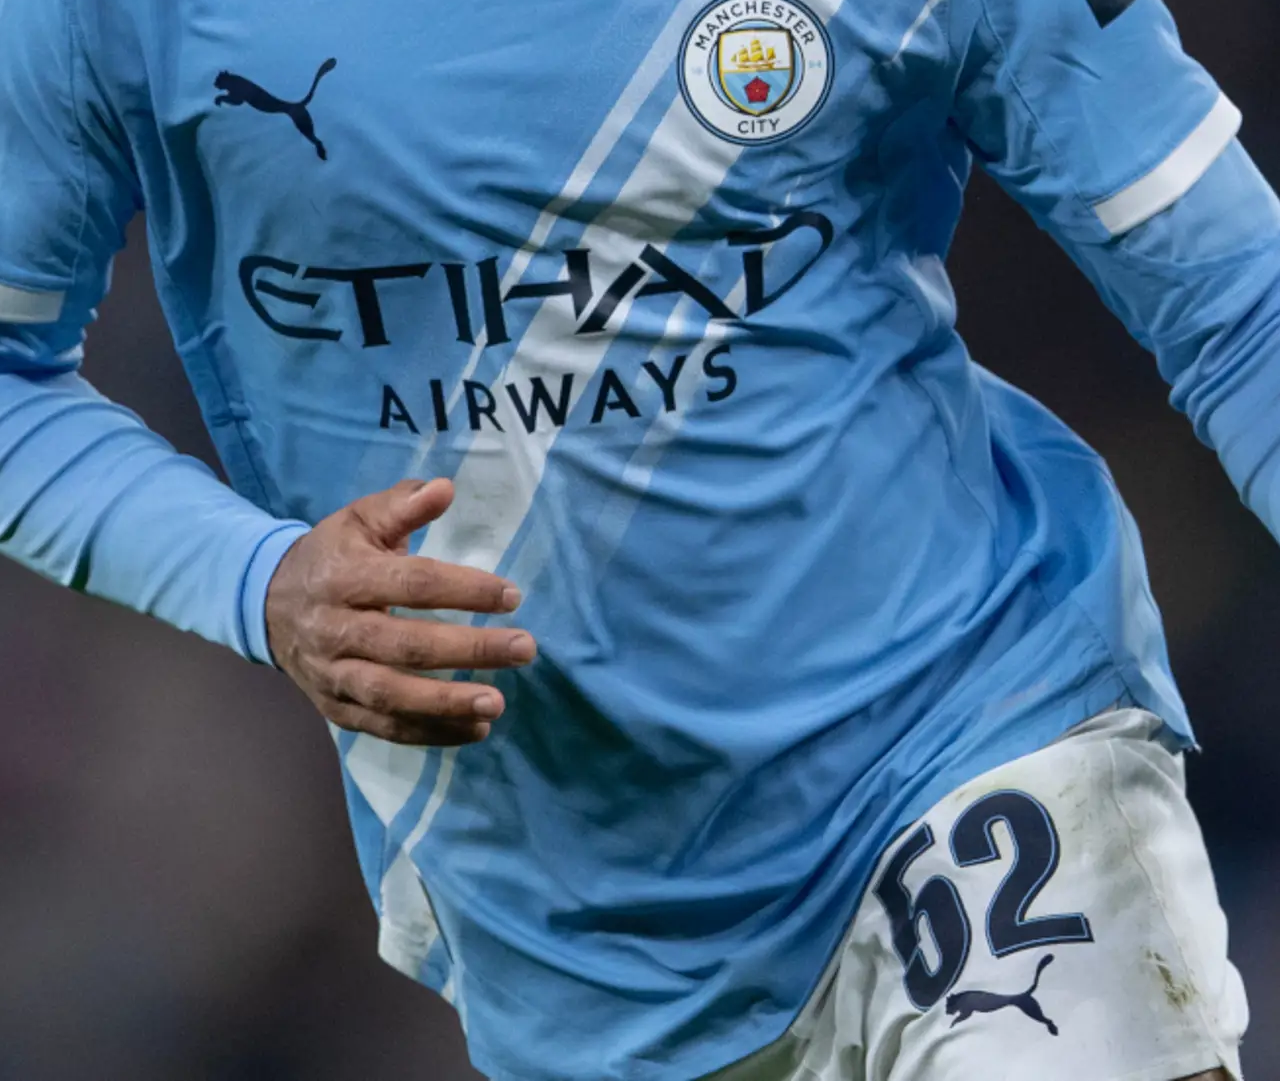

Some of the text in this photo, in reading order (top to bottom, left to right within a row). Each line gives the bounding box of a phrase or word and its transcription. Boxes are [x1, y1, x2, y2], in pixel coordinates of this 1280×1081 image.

[694, 0, 816, 51] MANCHESTER
[737, 118, 780, 134] CITY
[238, 211, 834, 347] ETIHAD
[378, 345, 738, 433] AIRWAYS
[872, 788, 1095, 1011] 52
